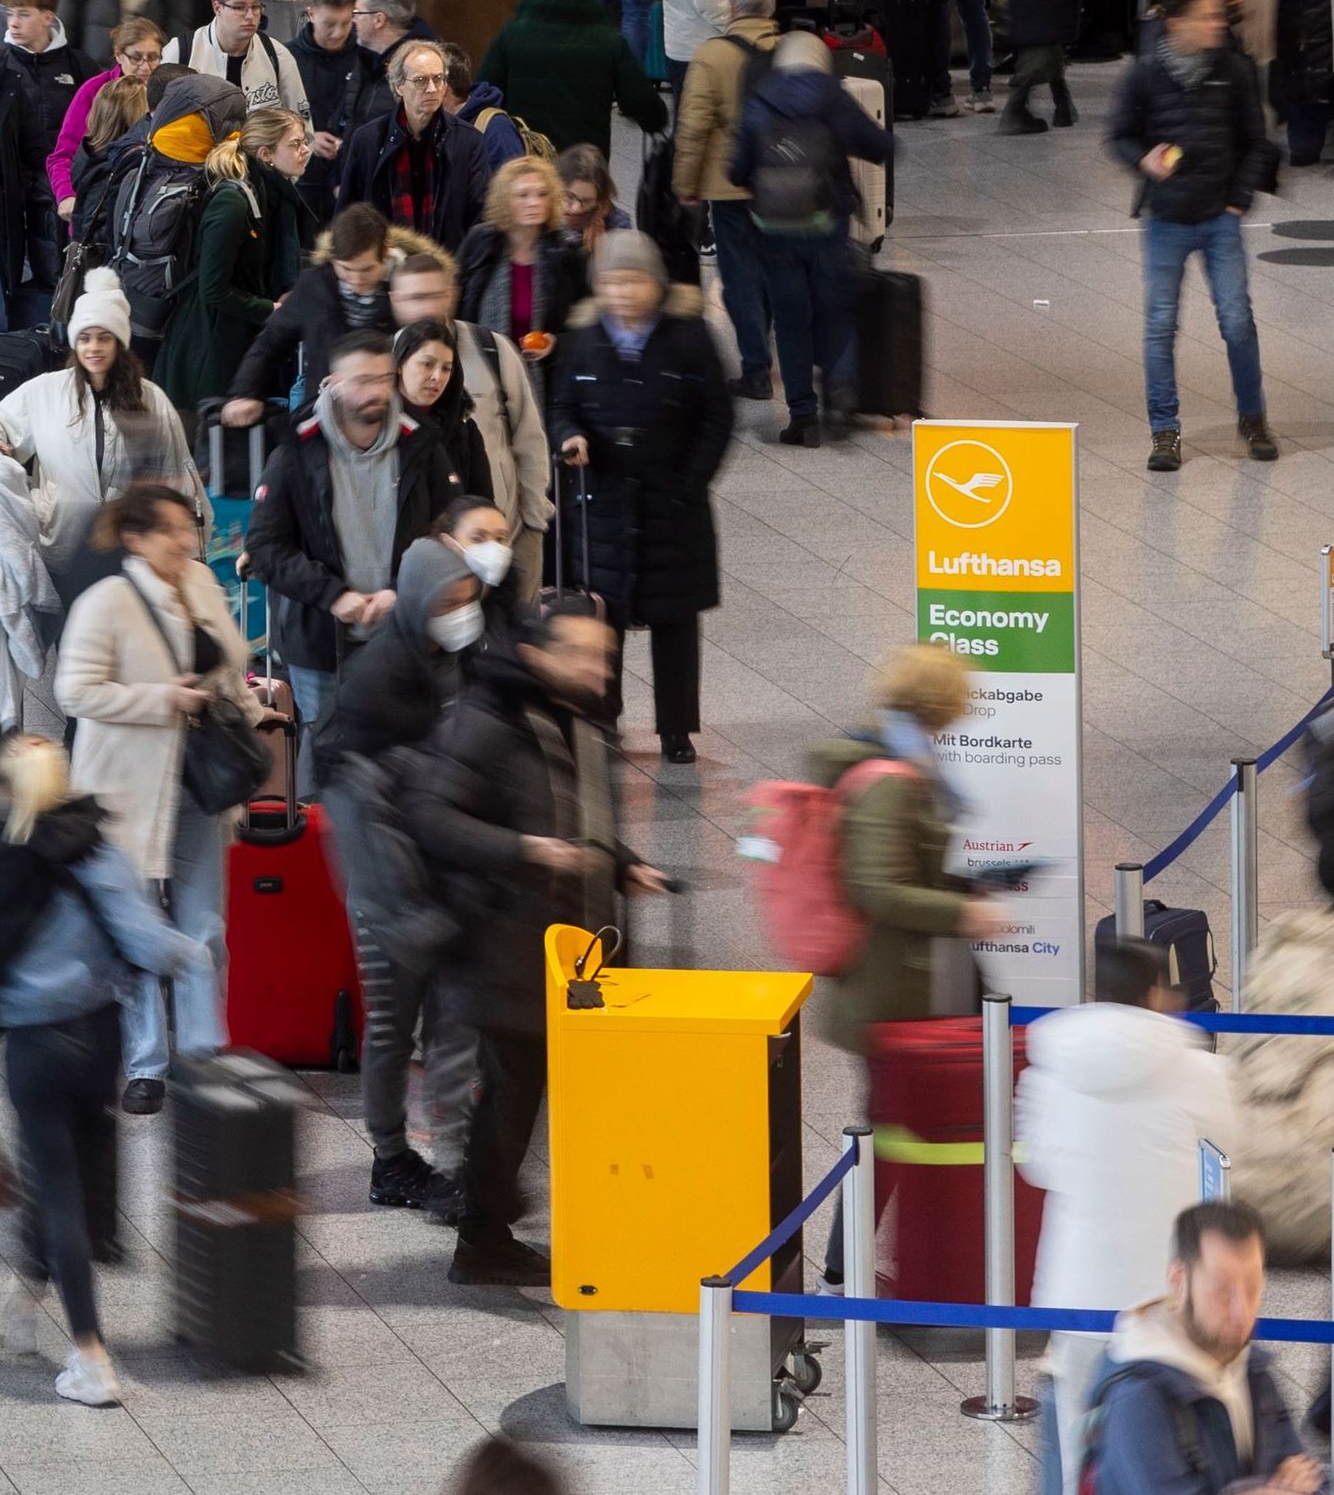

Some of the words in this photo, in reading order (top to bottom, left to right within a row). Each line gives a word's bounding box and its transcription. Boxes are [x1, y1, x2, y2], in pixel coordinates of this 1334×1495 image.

[929, 551, 1061, 576] Lufthansa
[930, 604, 1049, 633] Economy
[933, 734, 956, 747] Mit
[960, 735, 1032, 749] Bordkarte
[965, 752, 1025, 767] boarding
[1029, 753, 1061, 767] pass
[963, 839, 1013, 852] Austrian
[972, 941, 1028, 952] ufthansa
[1033, 942, 1060, 956] City
